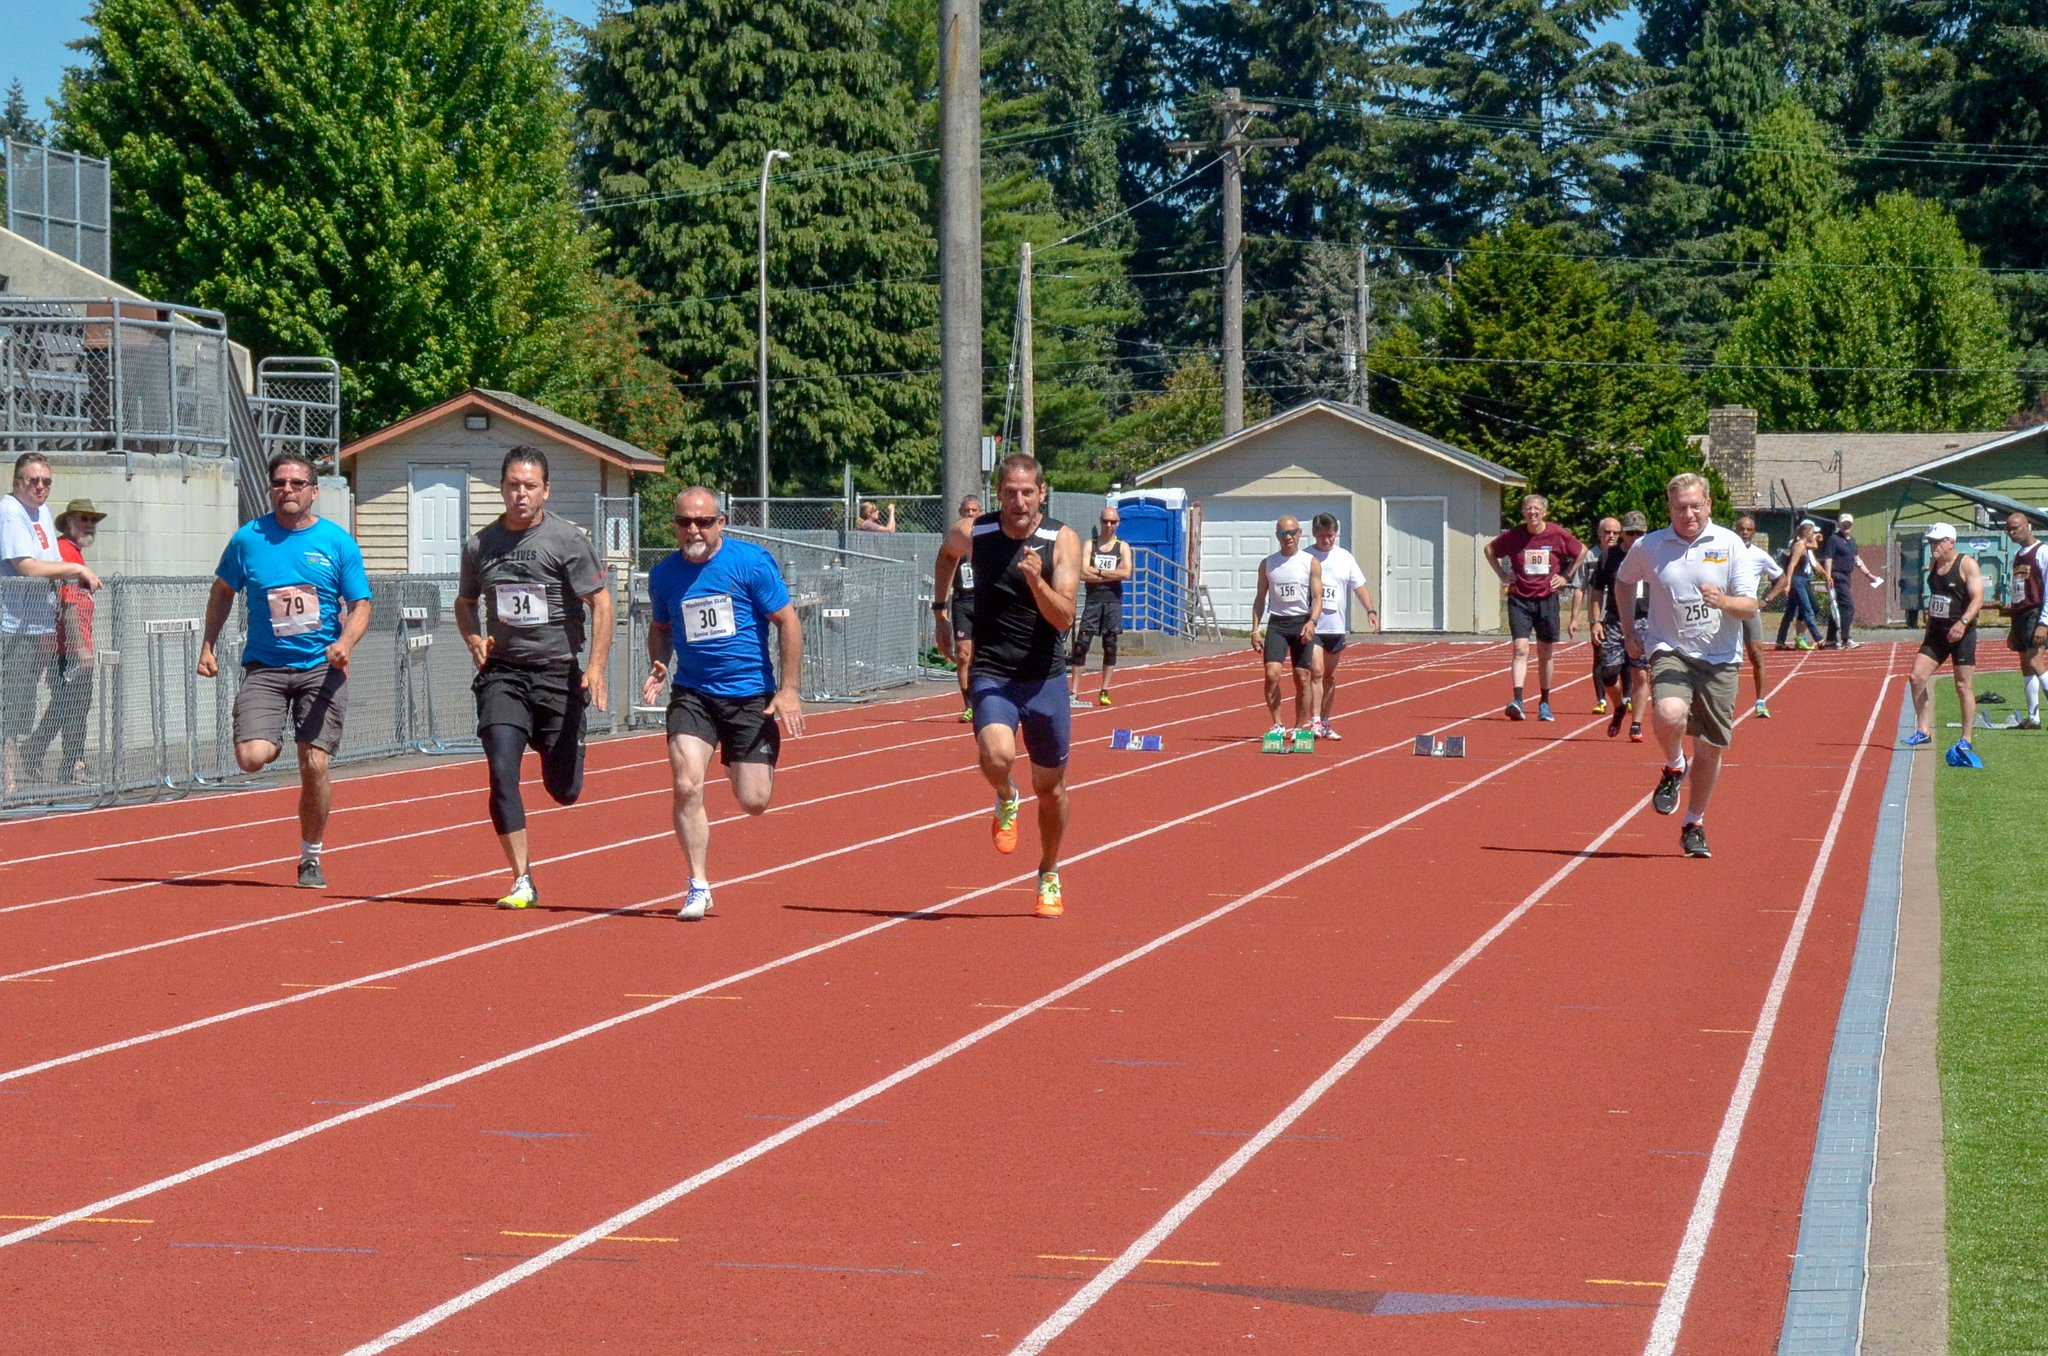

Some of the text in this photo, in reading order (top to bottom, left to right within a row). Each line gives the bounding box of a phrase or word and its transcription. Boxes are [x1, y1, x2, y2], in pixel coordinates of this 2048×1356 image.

[1531, 555, 1543, 565] 80
[1280, 585, 1295, 597] 156
[282, 596, 305, 616] 79
[512, 594, 531, 615] 34
[1684, 603, 1709, 622] 256
[698, 608, 717, 629] 30
